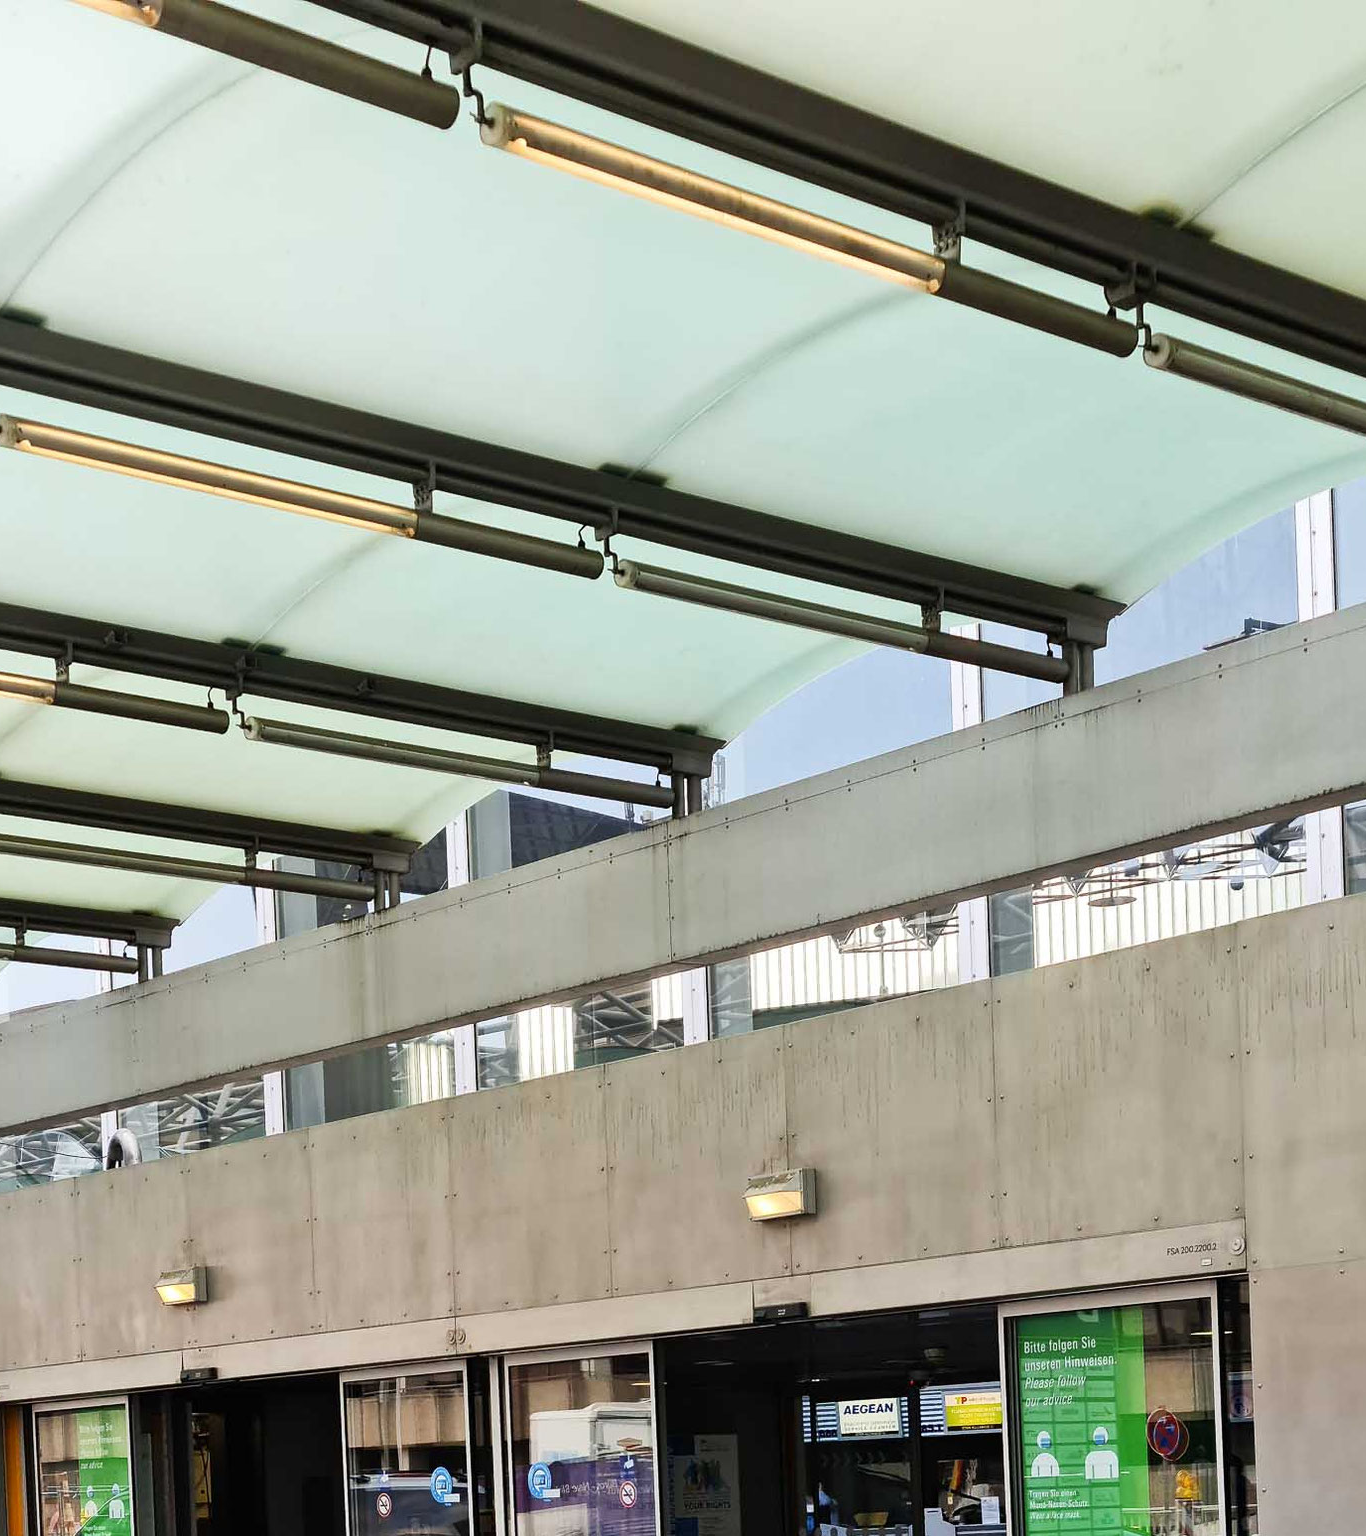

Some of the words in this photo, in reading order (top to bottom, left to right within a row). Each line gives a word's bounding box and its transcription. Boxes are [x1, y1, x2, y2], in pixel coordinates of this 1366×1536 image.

[1023, 1341, 1046, 1354] Bitte
[1048, 1339, 1078, 1354] folgen
[1081, 1336, 1097, 1349] Sie
[1024, 1359, 1061, 1372] unseren
[1064, 1354, 1118, 1369] Hinweisen.
[1024, 1376, 1055, 1390] Please
[1057, 1374, 1087, 1387] follow
[843, 1402, 894, 1416] AEGEAN
[1025, 1397, 1041, 1407] our
